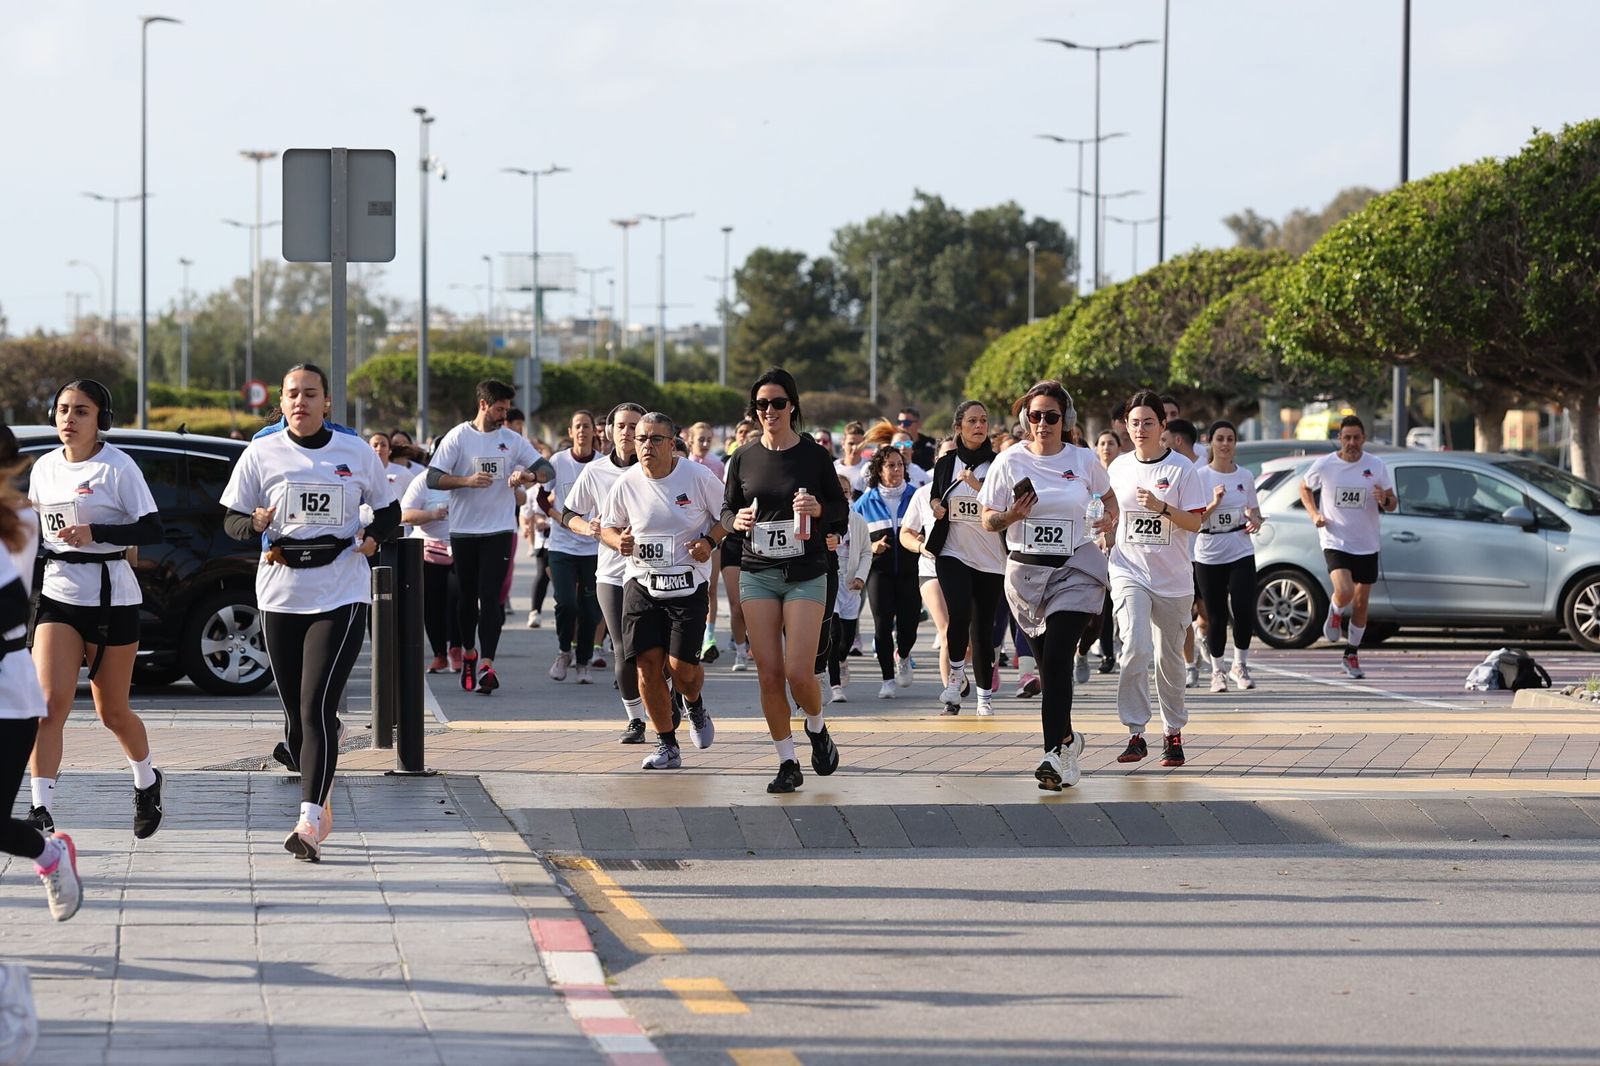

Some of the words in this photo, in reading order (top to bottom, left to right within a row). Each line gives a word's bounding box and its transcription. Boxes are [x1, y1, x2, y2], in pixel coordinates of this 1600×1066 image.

[481, 462, 497, 473] 105
[299, 492, 331, 512] 152
[1342, 491, 1360, 503] 244
[958, 501, 978, 515] 313
[44, 513, 66, 531] 126
[1134, 518, 1162, 534] 228
[1218, 513, 1232, 525] 59
[767, 529, 787, 547] 75
[1034, 526, 1063, 544] 252
[638, 543, 664, 559] 389
[655, 574, 689, 590] MARVEL
